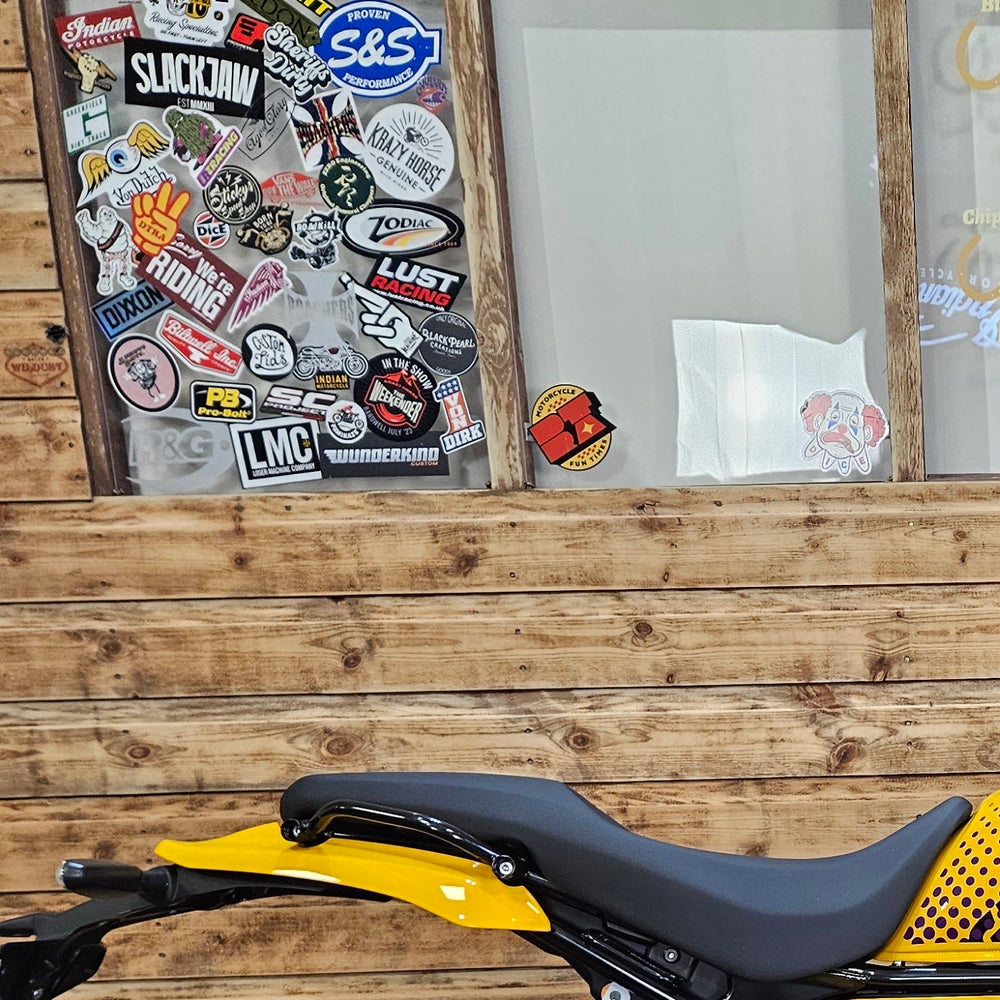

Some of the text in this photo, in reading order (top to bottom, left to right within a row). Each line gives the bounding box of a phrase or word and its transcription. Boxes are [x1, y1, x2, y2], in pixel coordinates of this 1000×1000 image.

[62, 16, 133, 43] Indian
[347, 9, 390, 22] PROVEN
[327, 27, 417, 68] S&S
[131, 53, 259, 107] SLACKJAW
[343, 68, 413, 89] PERFORMANCE
[367, 122, 409, 160] KRAZY
[405, 152, 446, 192] HORSE
[376, 156, 419, 190] GENUINE
[368, 215, 433, 243] ZODIAC
[145, 250, 227, 321] RIDING
[377, 257, 459, 292] LUST
[370, 276, 452, 306] RACING
[102, 283, 165, 329] DIXXON
[448, 333, 475, 348] PEARL
[315, 374, 348, 383] INDIAN
[382, 358, 434, 390] IN THE SHOW
[206, 387, 240, 408] PB
[369, 379, 423, 424] WEEKENDER
[393, 389, 406, 399] THE
[536, 388, 576, 417] MOTORCYCLE
[244, 426, 313, 469] LMC
[444, 424, 483, 451] DIRK
[589, 439, 607, 462] TIMES
[269, 466, 291, 475] MACHINE
[291, 463, 316, 473] COMPANY
[323, 447, 439, 463] WUNDERKIND
